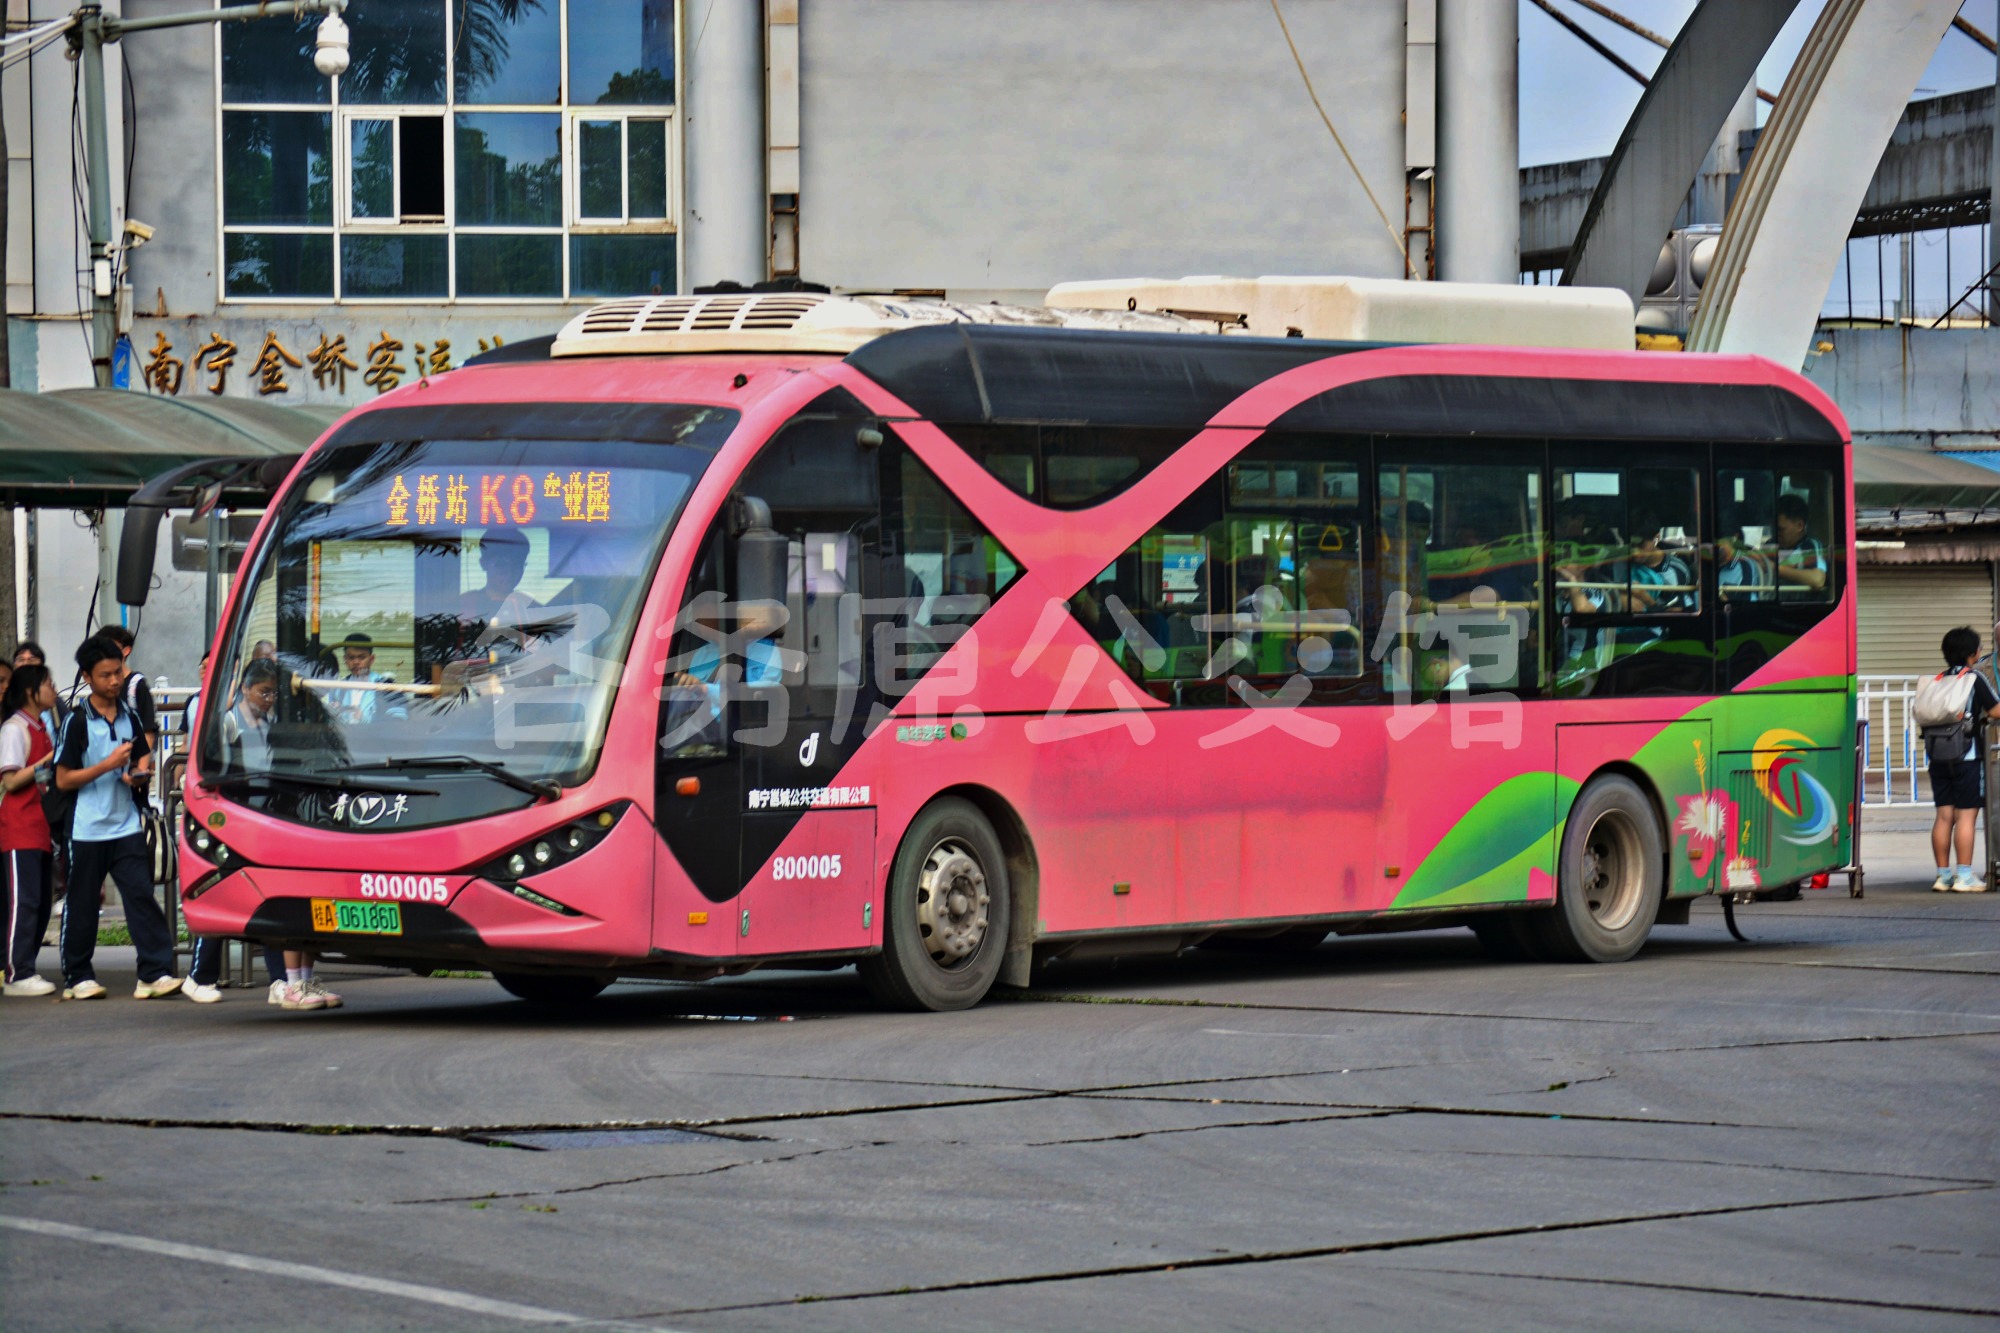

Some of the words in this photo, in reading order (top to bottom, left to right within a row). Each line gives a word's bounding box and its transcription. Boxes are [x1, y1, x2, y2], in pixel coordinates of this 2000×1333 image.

[386, 473, 469, 525] 金桥站
[480, 473, 537, 525] K8
[773, 854, 842, 881] 800005
[360, 873, 448, 902] 800005
